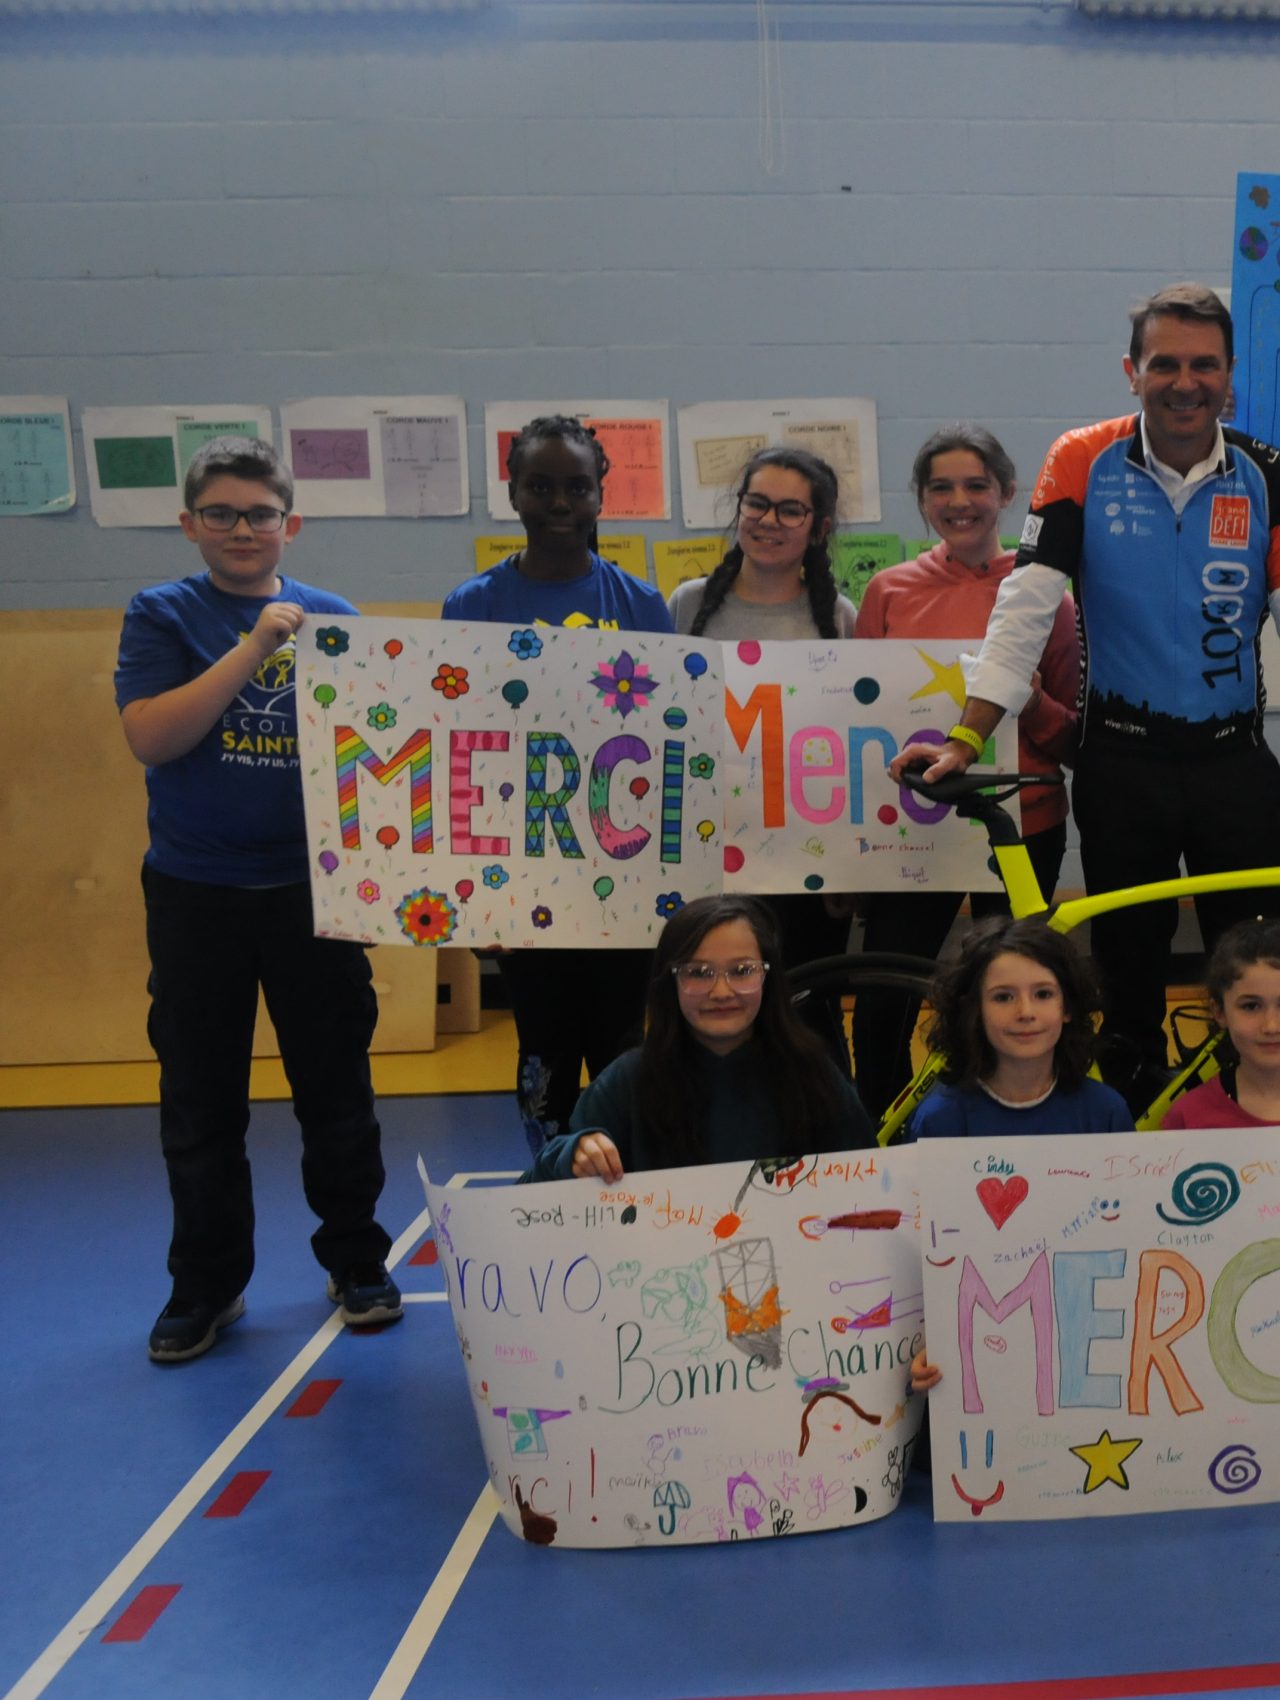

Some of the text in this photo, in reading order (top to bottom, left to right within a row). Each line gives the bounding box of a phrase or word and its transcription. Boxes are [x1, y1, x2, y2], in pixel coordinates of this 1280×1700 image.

[446, 1254, 607, 1323] ravo,
[598, 1321, 776, 1414] Bonne
[503, 1447, 598, 1522] rci!
